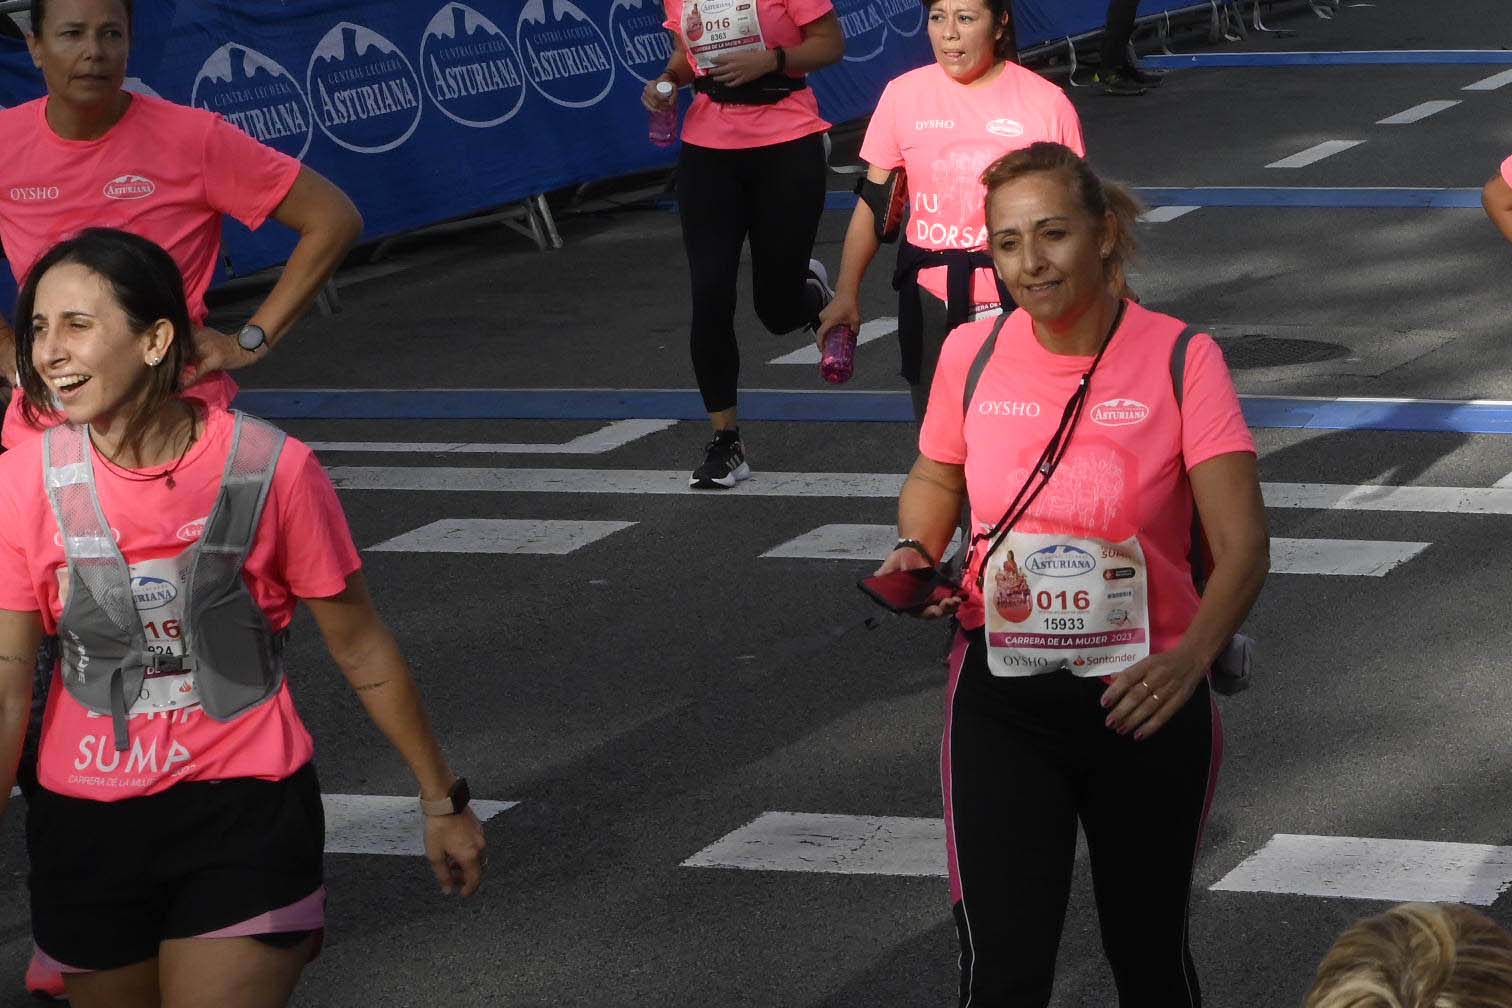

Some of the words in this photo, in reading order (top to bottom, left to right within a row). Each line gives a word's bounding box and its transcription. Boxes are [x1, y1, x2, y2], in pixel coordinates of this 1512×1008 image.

[705, 17, 731, 32] 016
[619, 23, 674, 66] ASTUR
[525, 38, 610, 82] ASTURIANA
[430, 53, 521, 102] ASTURIANA
[318, 76, 418, 127] ASTURIANA
[203, 100, 308, 141] TURIANA
[10, 186, 59, 201] OYSHO
[917, 219, 989, 247] DORSA
[979, 400, 1041, 417] OYSHO
[1095, 407, 1145, 421] ASTURIANA
[1030, 557, 1091, 570] ASTURIANA
[1036, 590, 1090, 611] 016
[145, 618, 181, 640] 16
[1043, 617, 1085, 631] 15933
[1005, 636, 1048, 645] CARRERA
[1048, 637, 1060, 646] DE
[1062, 637, 1073, 646] LA
[1075, 635, 1108, 646] MUJER
[1111, 633, 1133, 642] 2023
[1003, 654, 1049, 667] OYSHO
[1086, 652, 1137, 666] Santander
